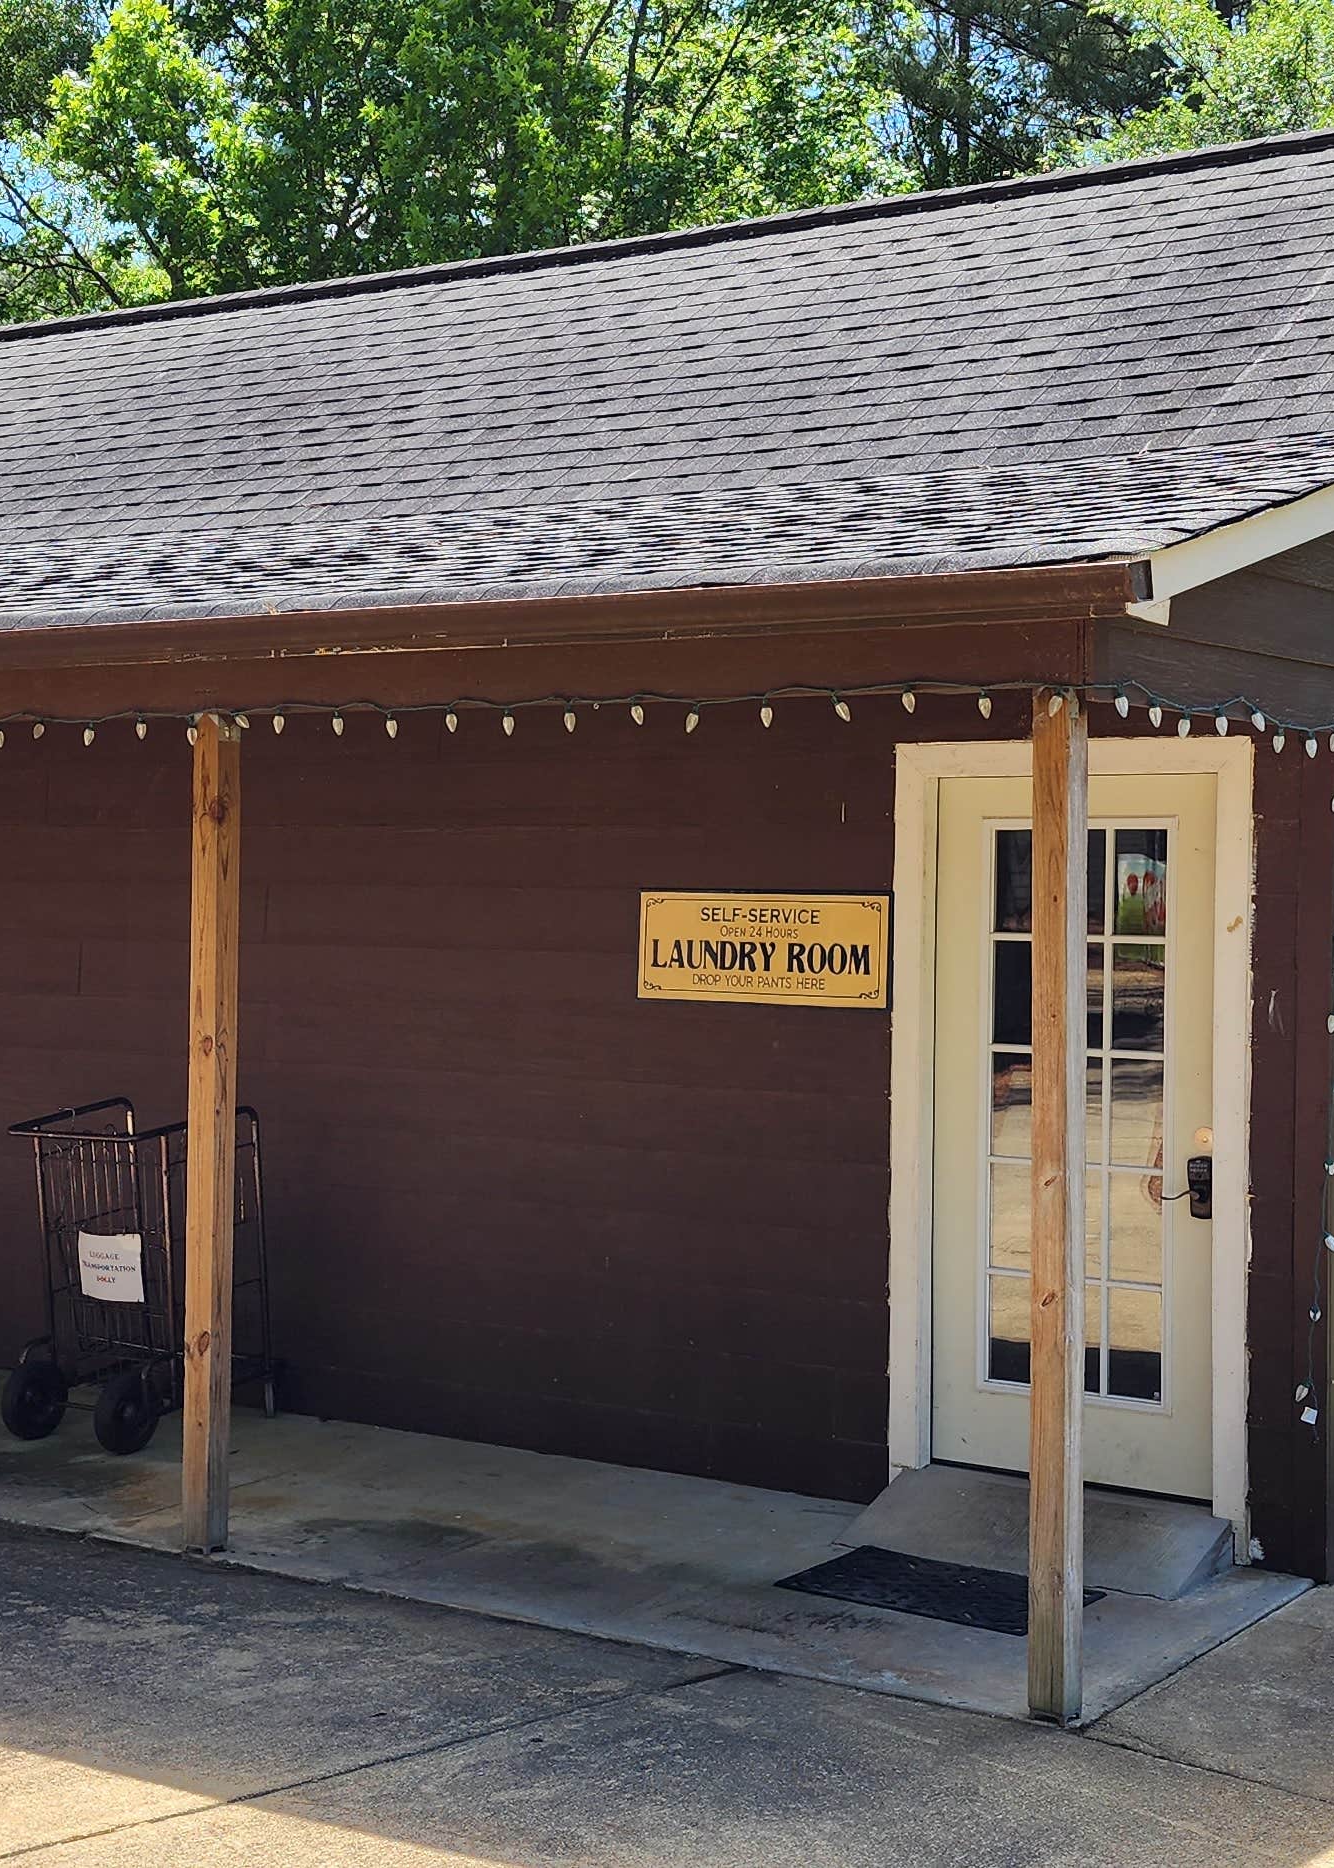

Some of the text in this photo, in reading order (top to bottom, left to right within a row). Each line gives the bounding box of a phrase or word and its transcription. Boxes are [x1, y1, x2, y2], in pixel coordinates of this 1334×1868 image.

[701, 907, 820, 924] SELF-SERVICE
[720, 926, 798, 939] OPEN 24 HOURS
[651, 939, 870, 975] LAUNDRY ROOM
[693, 974, 825, 990] DROP YOUR PANTS HERE
